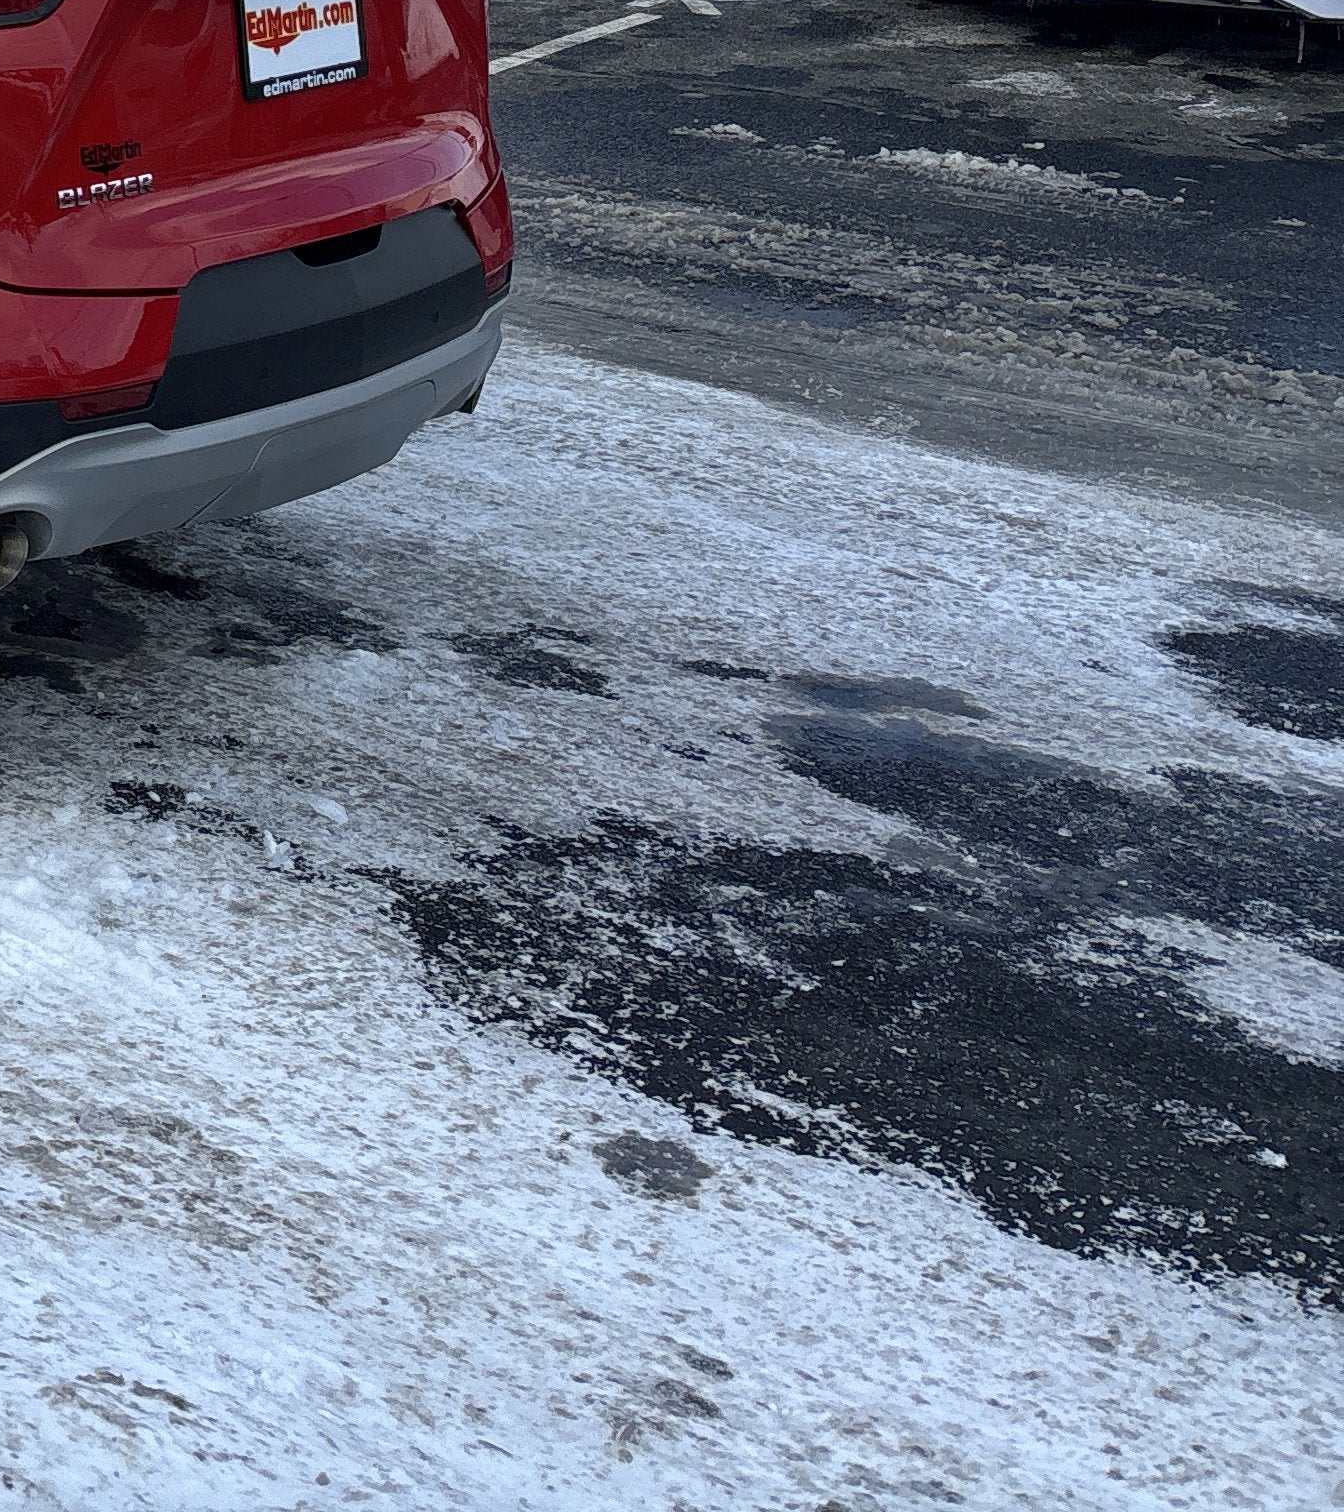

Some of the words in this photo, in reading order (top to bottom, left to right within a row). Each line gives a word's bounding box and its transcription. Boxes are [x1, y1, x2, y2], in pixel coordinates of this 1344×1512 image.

[246, 1, 355, 41] EdMartin.com
[263, 66, 357, 98] edmartin.com
[57, 173, 153, 209] BLAZER
